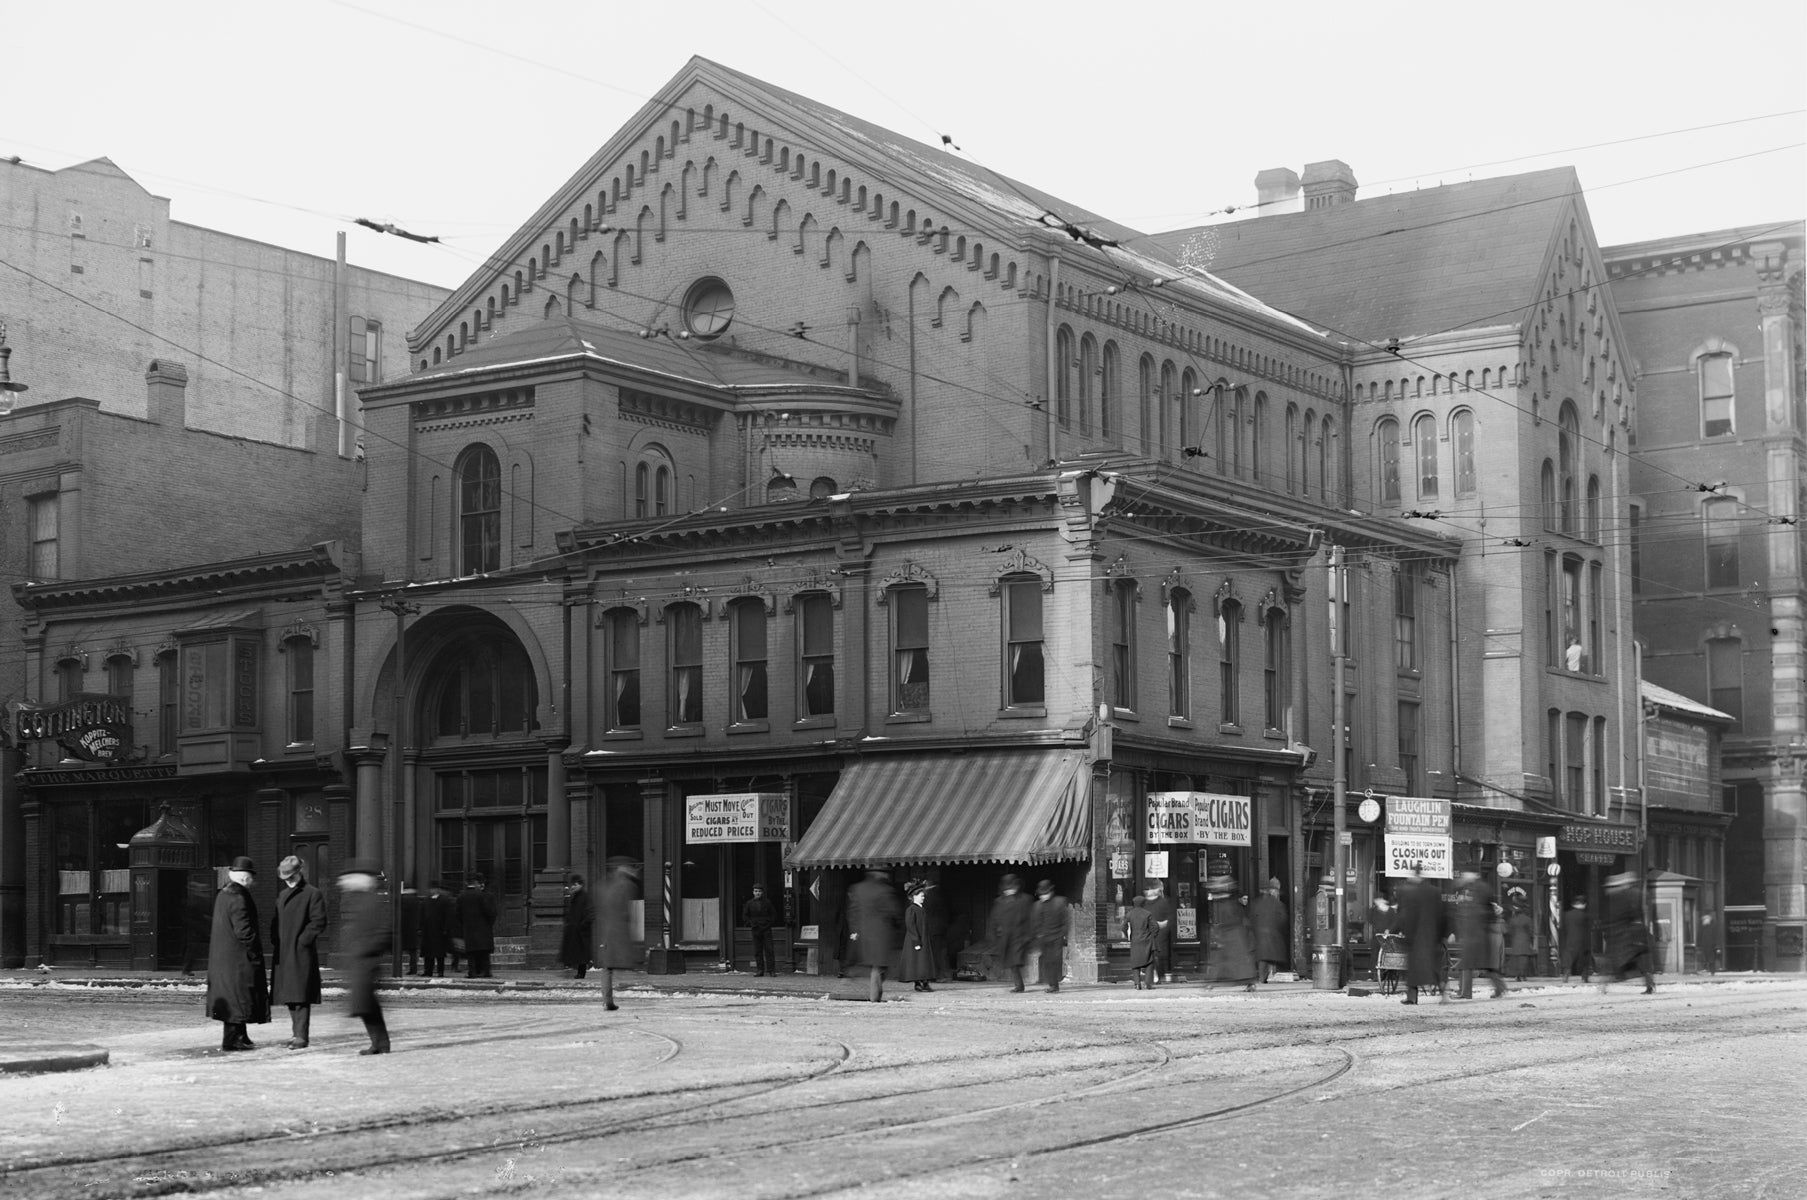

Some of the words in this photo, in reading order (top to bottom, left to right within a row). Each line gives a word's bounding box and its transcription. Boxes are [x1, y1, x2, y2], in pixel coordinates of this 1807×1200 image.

[19, 700, 127, 739] COTTINGTON
[88, 737, 120, 755] MELCHERS
[36, 772, 70, 784] THE
[73, 767, 176, 783] MARQUETTE
[704, 799, 722, 812] MUST
[723, 799, 740, 812] MOVE
[761, 799, 787, 817] CIGARS
[1148, 797, 1171, 811] Popular
[1171, 797, 1190, 808] Brand
[1195, 797, 1209, 815] Popular
[1395, 799, 1441, 814] LAUGHLIN
[690, 813, 703, 821] SOLD
[706, 816, 731, 825] CIGARS
[742, 811, 754, 819] OUT
[768, 815, 776, 825] BY
[776, 815, 785, 825] THE
[1148, 812, 1189, 829] CIGARS
[1195, 814, 1209, 827] Brand
[1209, 799, 1249, 830] CIGARS
[1388, 813, 1430, 826] FOUNTAIN
[1431, 814, 1450, 827] PEN
[691, 827, 723, 838] REDUCED
[727, 826, 754, 837] PRICES
[763, 827, 787, 837] BOX
[1213, 831, 1228, 840] THE
[1594, 828, 1633, 846] HOUSE
[1392, 847, 1429, 859] CLOSING
[1430, 849, 1446, 859] OUT
[1393, 859, 1423, 871] SALE
